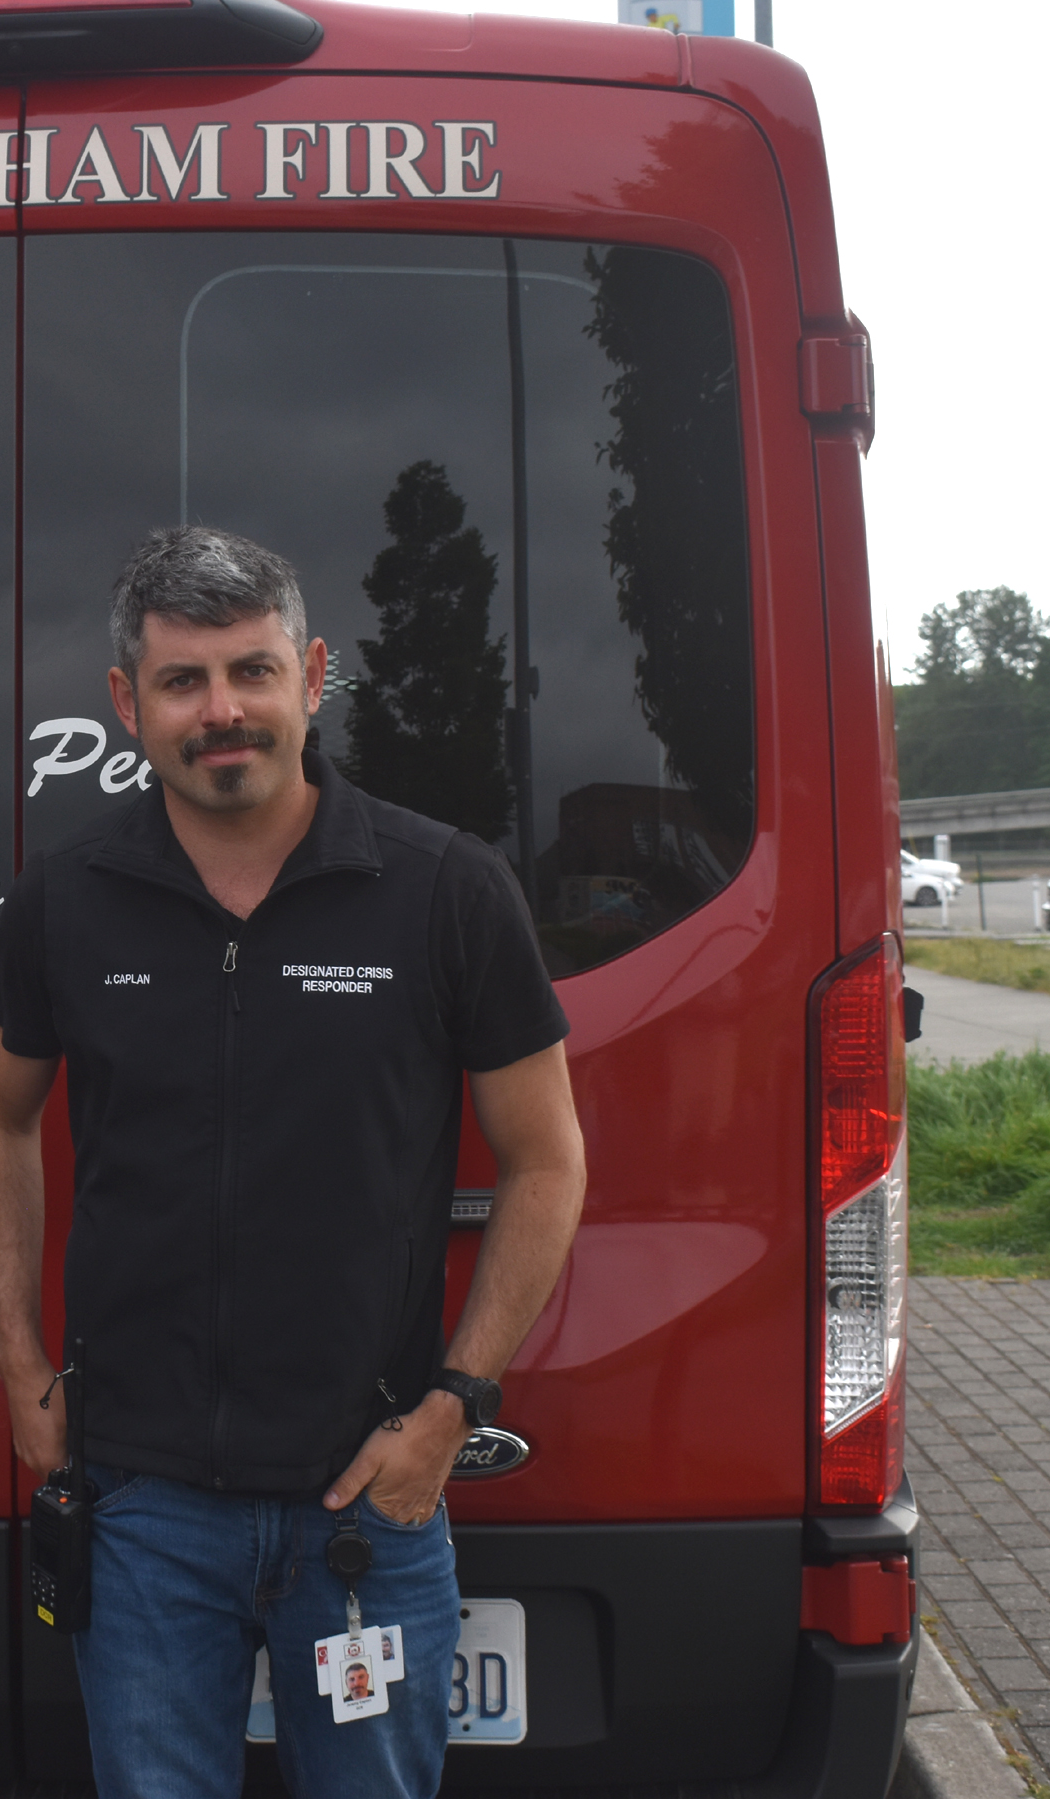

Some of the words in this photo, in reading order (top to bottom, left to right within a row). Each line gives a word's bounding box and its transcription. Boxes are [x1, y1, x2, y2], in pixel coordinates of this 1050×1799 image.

[255, 120, 501, 200] FIRE
[282, 964, 355, 978] DESIGNATED
[356, 966, 394, 980] CRISIS
[302, 979, 372, 993] RESPONDER
